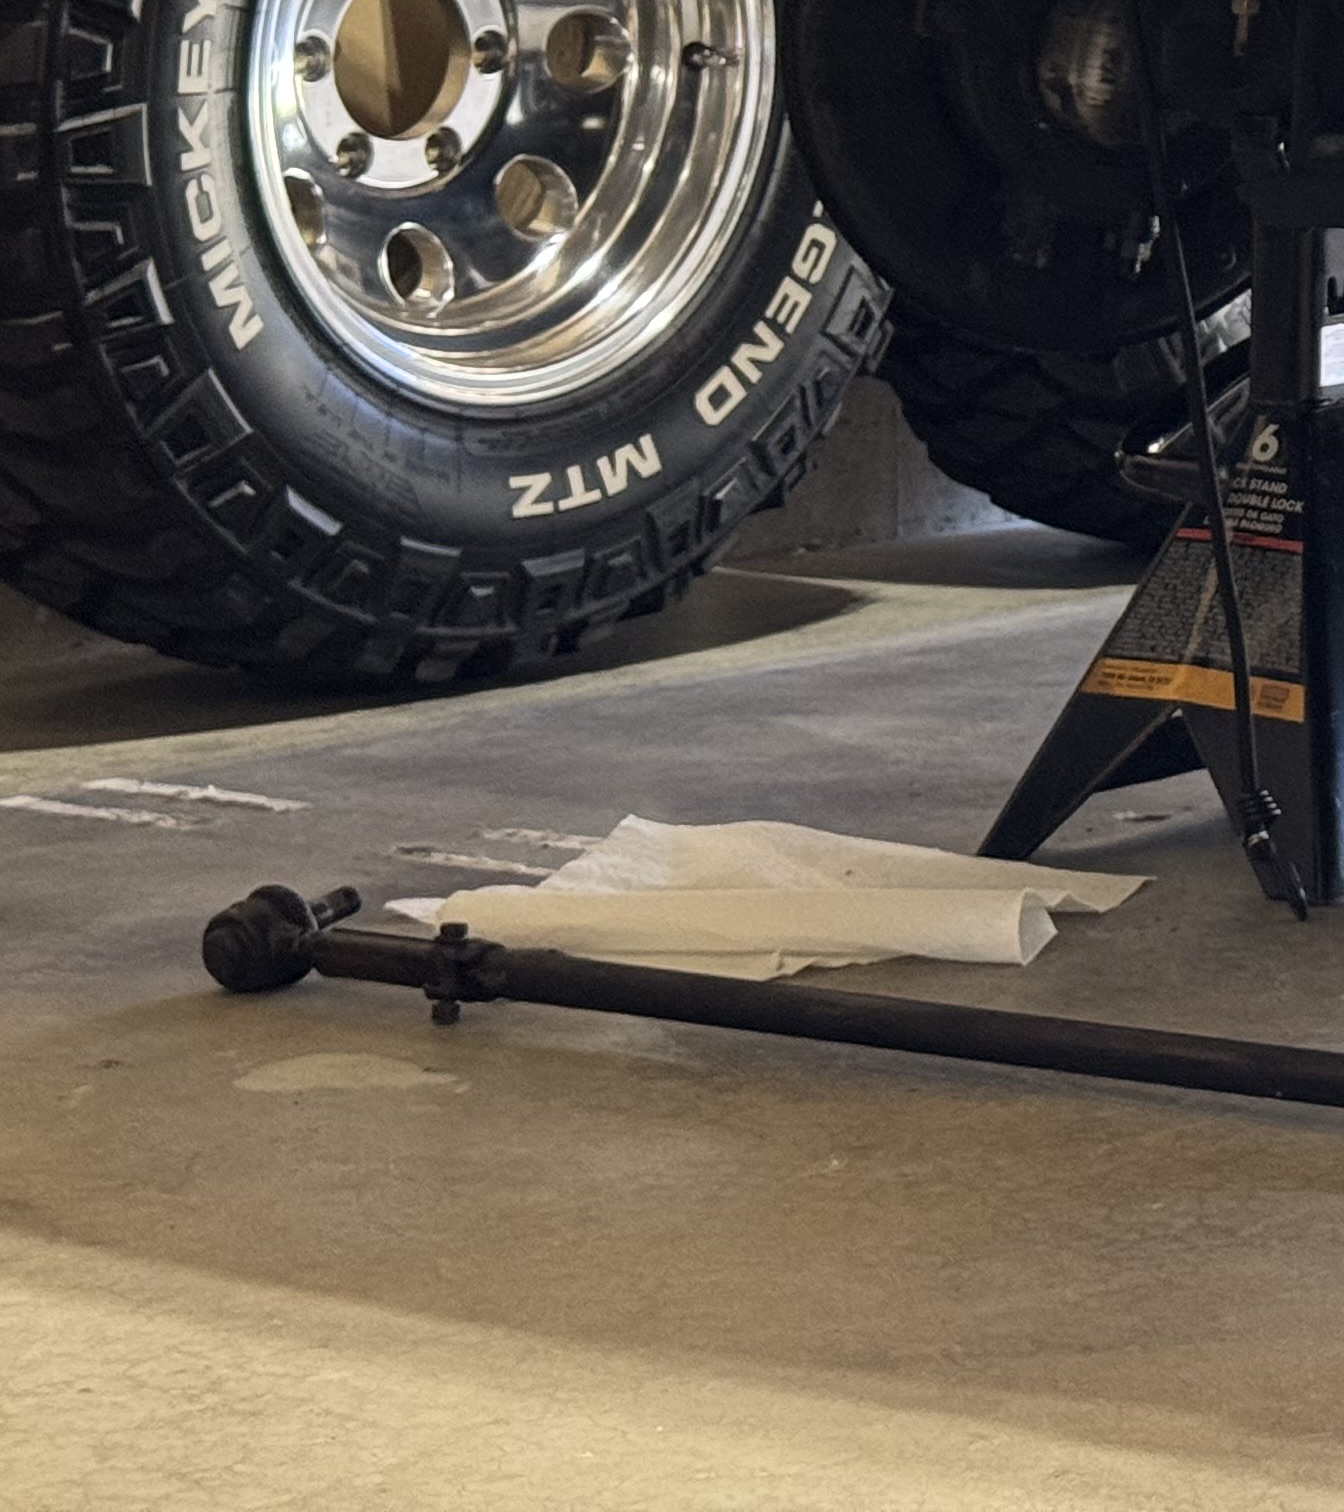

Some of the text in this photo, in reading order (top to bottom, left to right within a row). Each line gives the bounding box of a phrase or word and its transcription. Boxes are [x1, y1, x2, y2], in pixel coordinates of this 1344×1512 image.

[691, 200, 837, 426] GEND
[1252, 424, 1280, 461] 6
[509, 433, 661, 519] MTZ
[1249, 478, 1288, 494] STAND
[1271, 497, 1305, 514] LOCK
